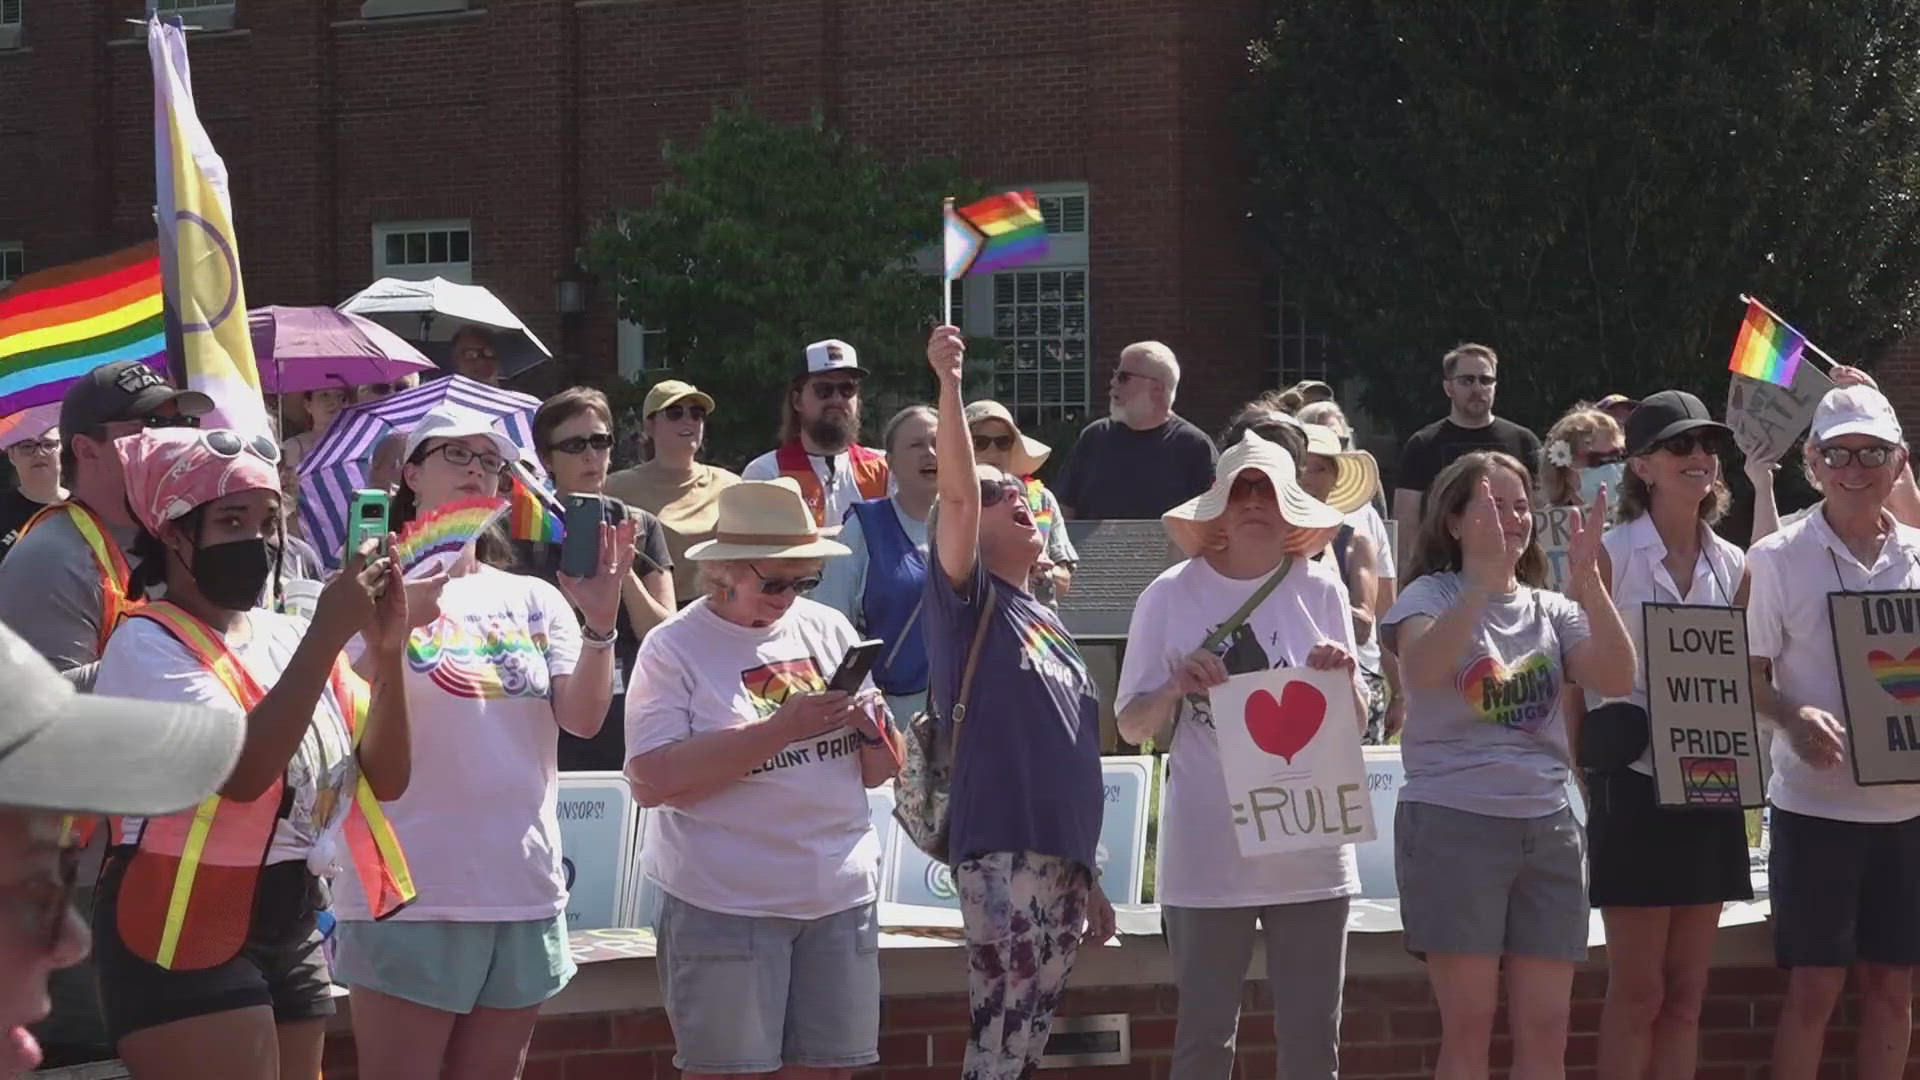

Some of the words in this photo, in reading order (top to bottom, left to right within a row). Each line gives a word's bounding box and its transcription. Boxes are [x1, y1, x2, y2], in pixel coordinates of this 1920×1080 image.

[1861, 598, 1920, 635] LOV
[1669, 627, 1735, 655] LOVE
[1483, 665, 1554, 710] MOM
[1666, 676, 1738, 704] WITH
[1670, 727, 1749, 757] PRIDE
